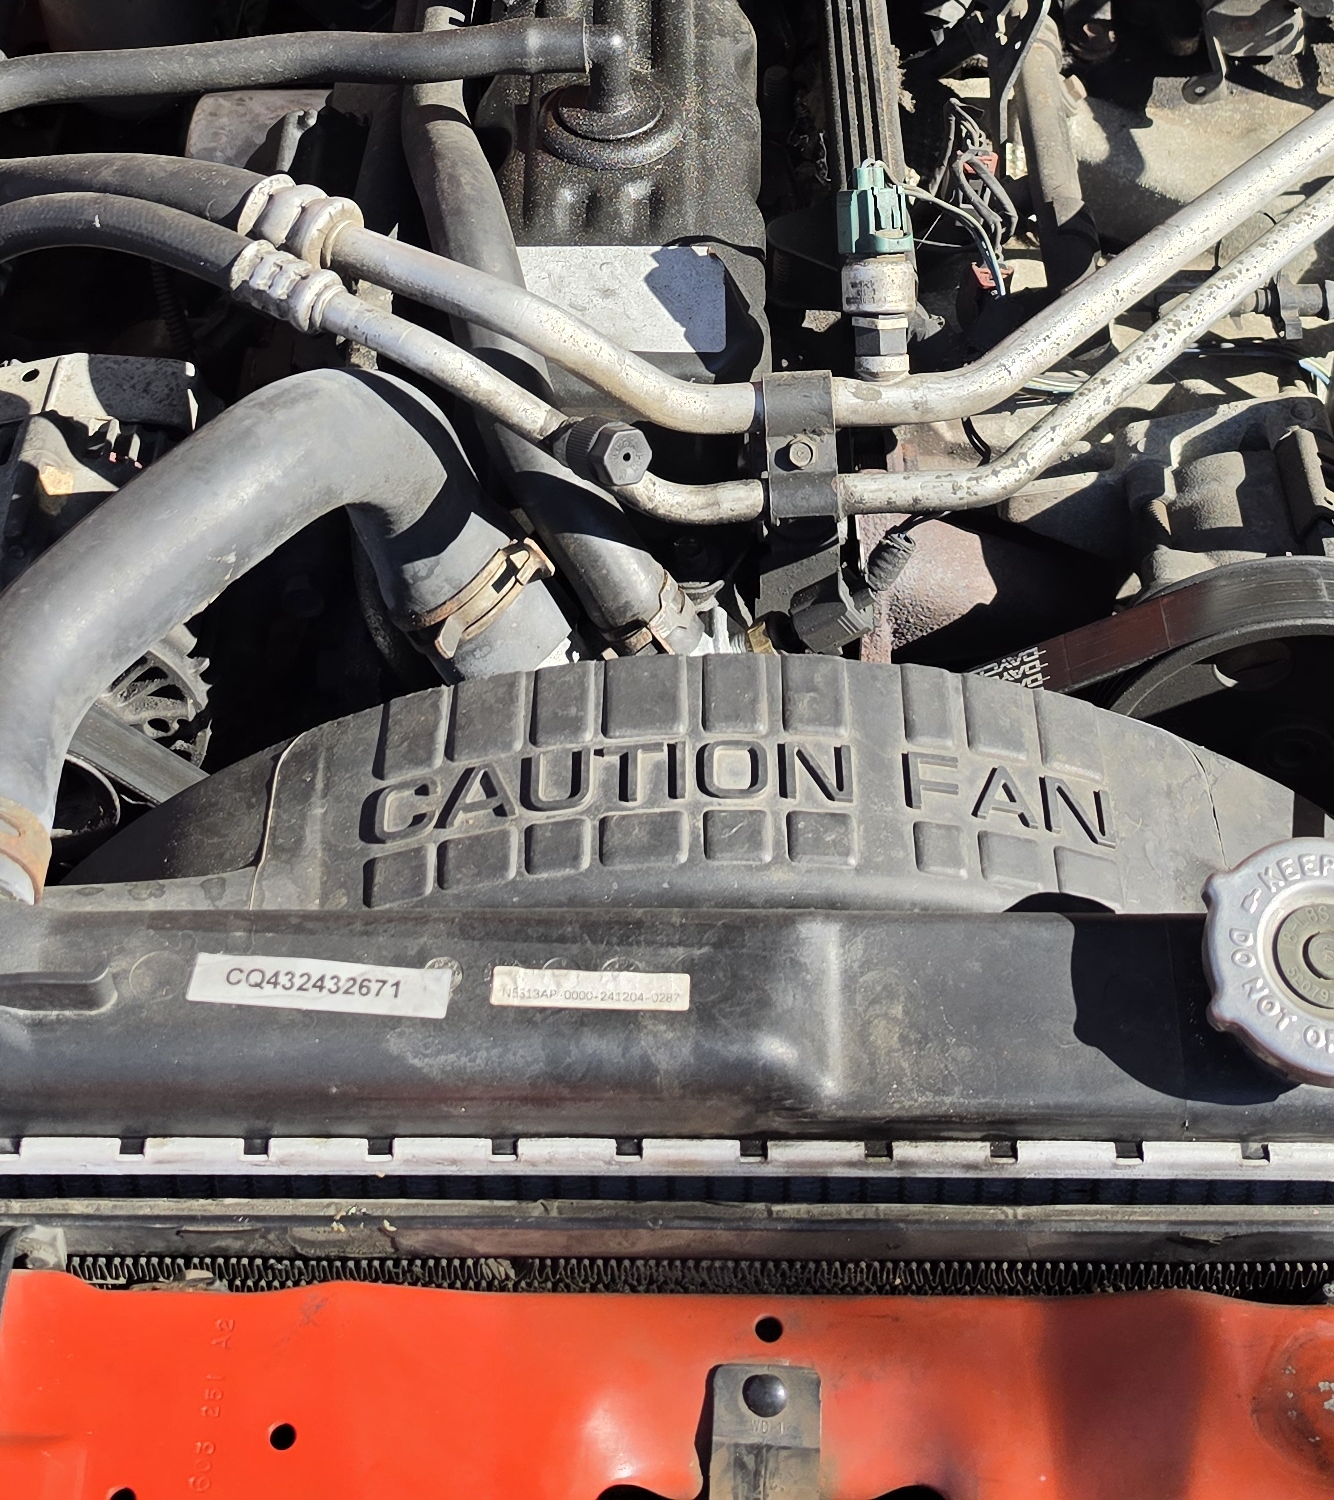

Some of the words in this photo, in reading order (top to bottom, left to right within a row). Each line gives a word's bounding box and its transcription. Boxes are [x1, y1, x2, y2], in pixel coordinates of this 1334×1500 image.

[358, 739, 855, 846] CAUTION
[901, 751, 1117, 848] FAN
[1229, 927, 1257, 969] DO
[224, 966, 403, 1000] CQ432432671
[1241, 976, 1298, 1032] NOT
